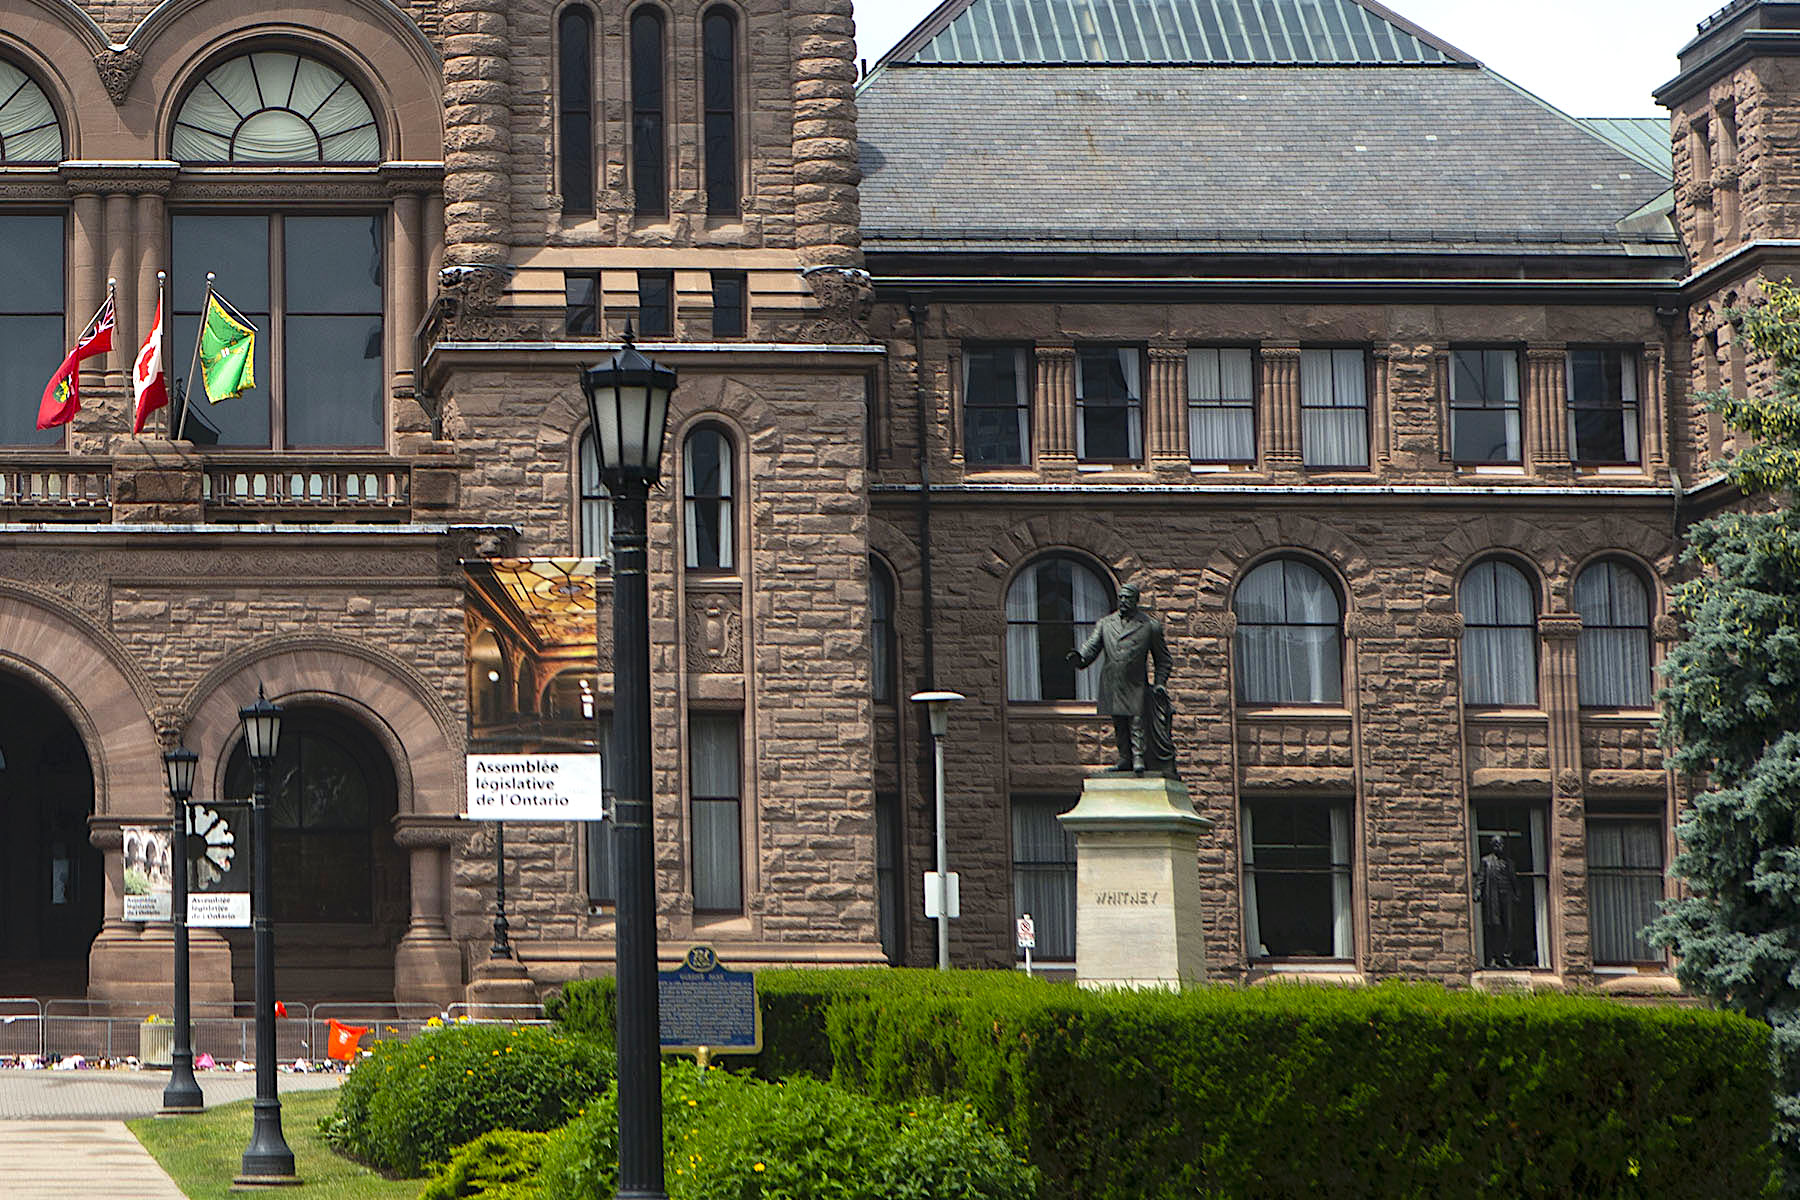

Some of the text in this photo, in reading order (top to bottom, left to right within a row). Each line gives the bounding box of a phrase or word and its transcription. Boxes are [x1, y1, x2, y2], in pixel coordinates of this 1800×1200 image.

[476, 759, 560, 774] Assemblée
[476, 776, 555, 793] législative
[476, 792, 569, 806] de l'Ontario
[1096, 891, 1158, 905] WHITNEY
